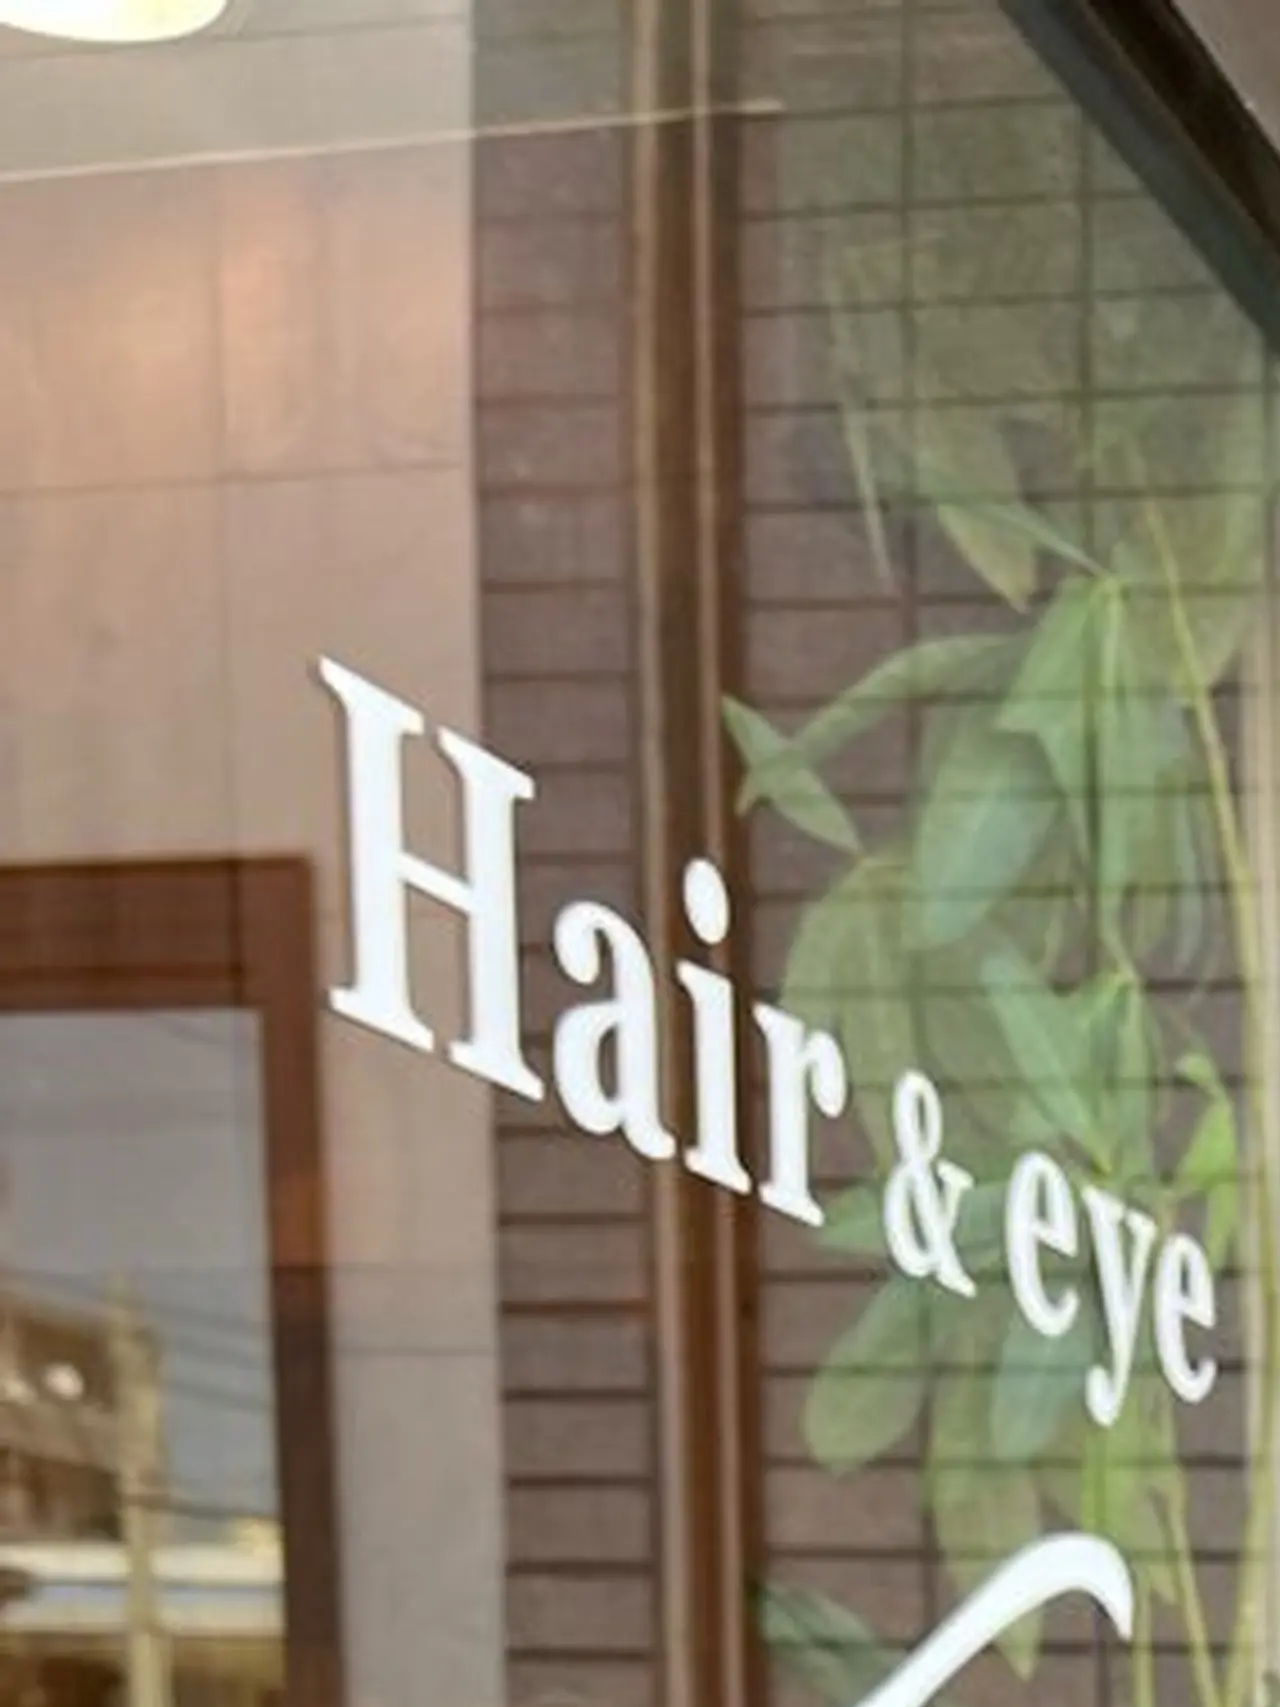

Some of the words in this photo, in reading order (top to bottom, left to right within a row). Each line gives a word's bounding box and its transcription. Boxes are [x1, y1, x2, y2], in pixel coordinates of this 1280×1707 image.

[319, 656, 845, 1225] Hair
[882, 1071, 976, 1298] &
[1004, 1152, 1217, 1426] eye
